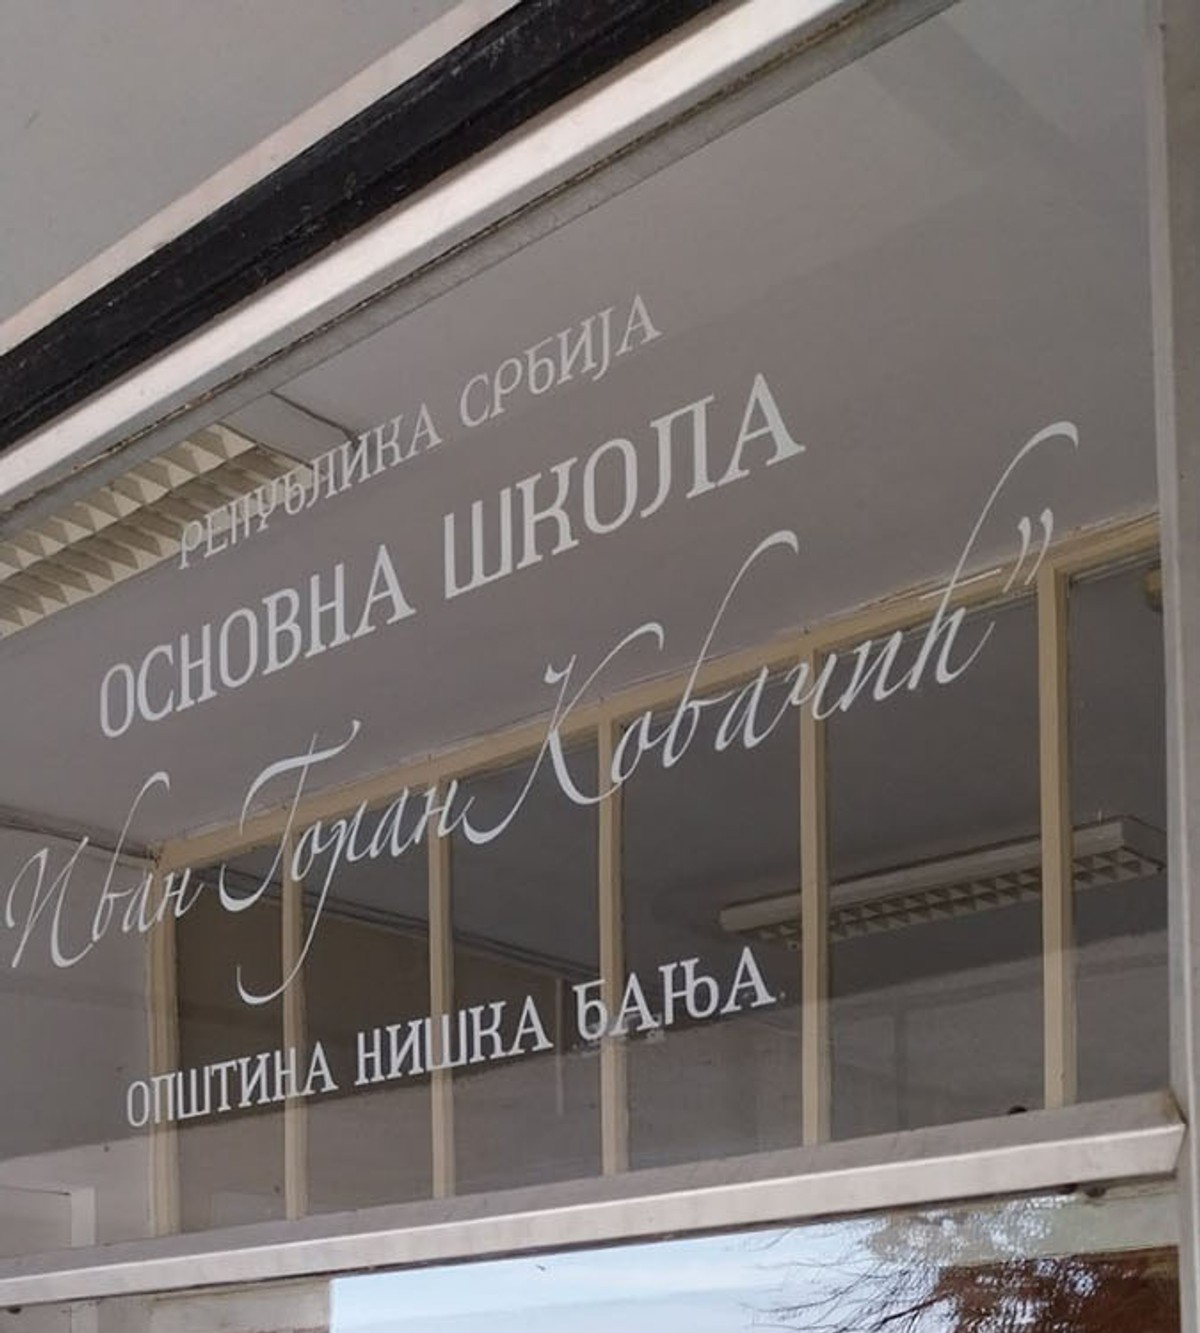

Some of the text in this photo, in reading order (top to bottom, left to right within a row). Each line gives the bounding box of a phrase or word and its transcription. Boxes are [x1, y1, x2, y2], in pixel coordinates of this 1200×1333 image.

[100, 373, 805, 738] ОСНОВНА ШКОЛА
[179, 294, 663, 569] РЕПУБЛИКА СРБИЈА
[219, 720, 474, 1004] Горан
[126, 946, 774, 1128] ОПШТИНА НИШКА БАЊА
